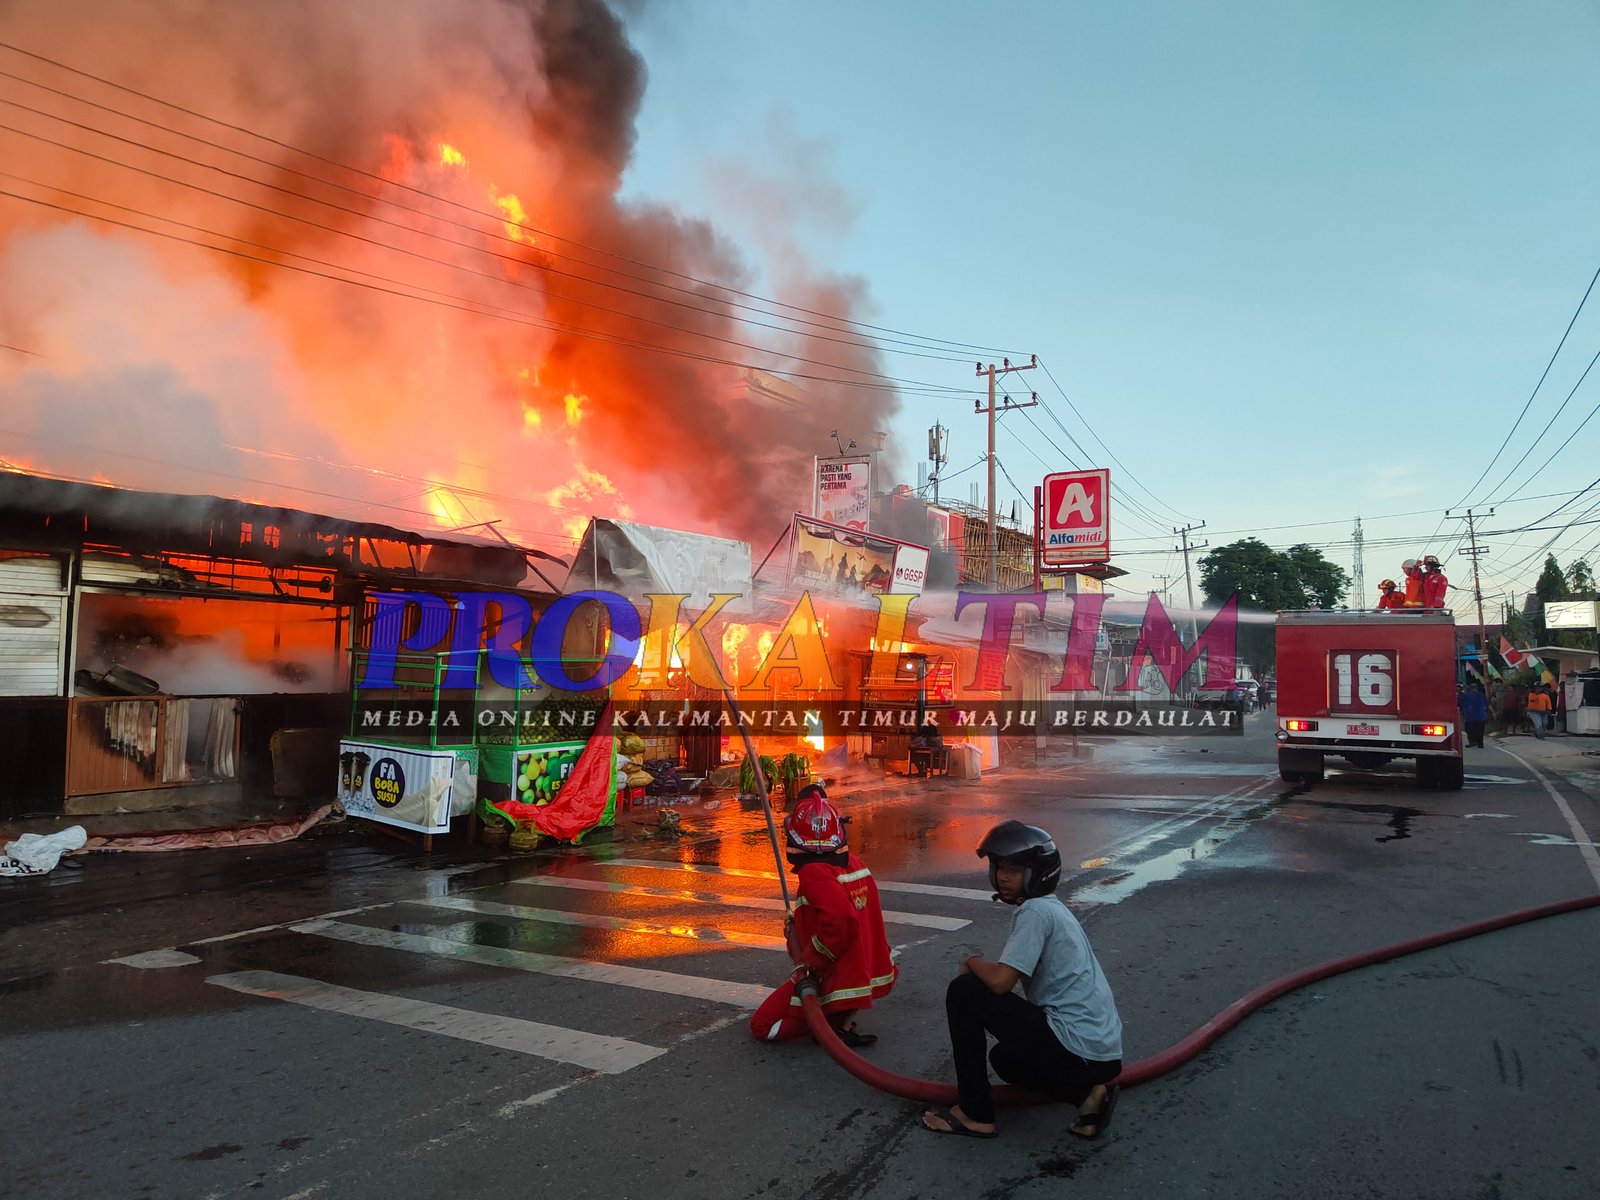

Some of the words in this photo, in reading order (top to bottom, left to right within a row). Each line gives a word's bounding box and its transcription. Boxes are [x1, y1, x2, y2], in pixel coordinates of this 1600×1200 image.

[821, 465, 843, 473] KARENA
[821, 473, 836, 481] PASTI
[821, 482, 847, 490] PERTAMA
[1049, 531, 1102, 544] Alfamidi
[903, 568, 923, 583] GGSP
[1334, 654, 1393, 706] 16
[380, 762, 396, 780] FA
[377, 791, 397, 804] SUSU
